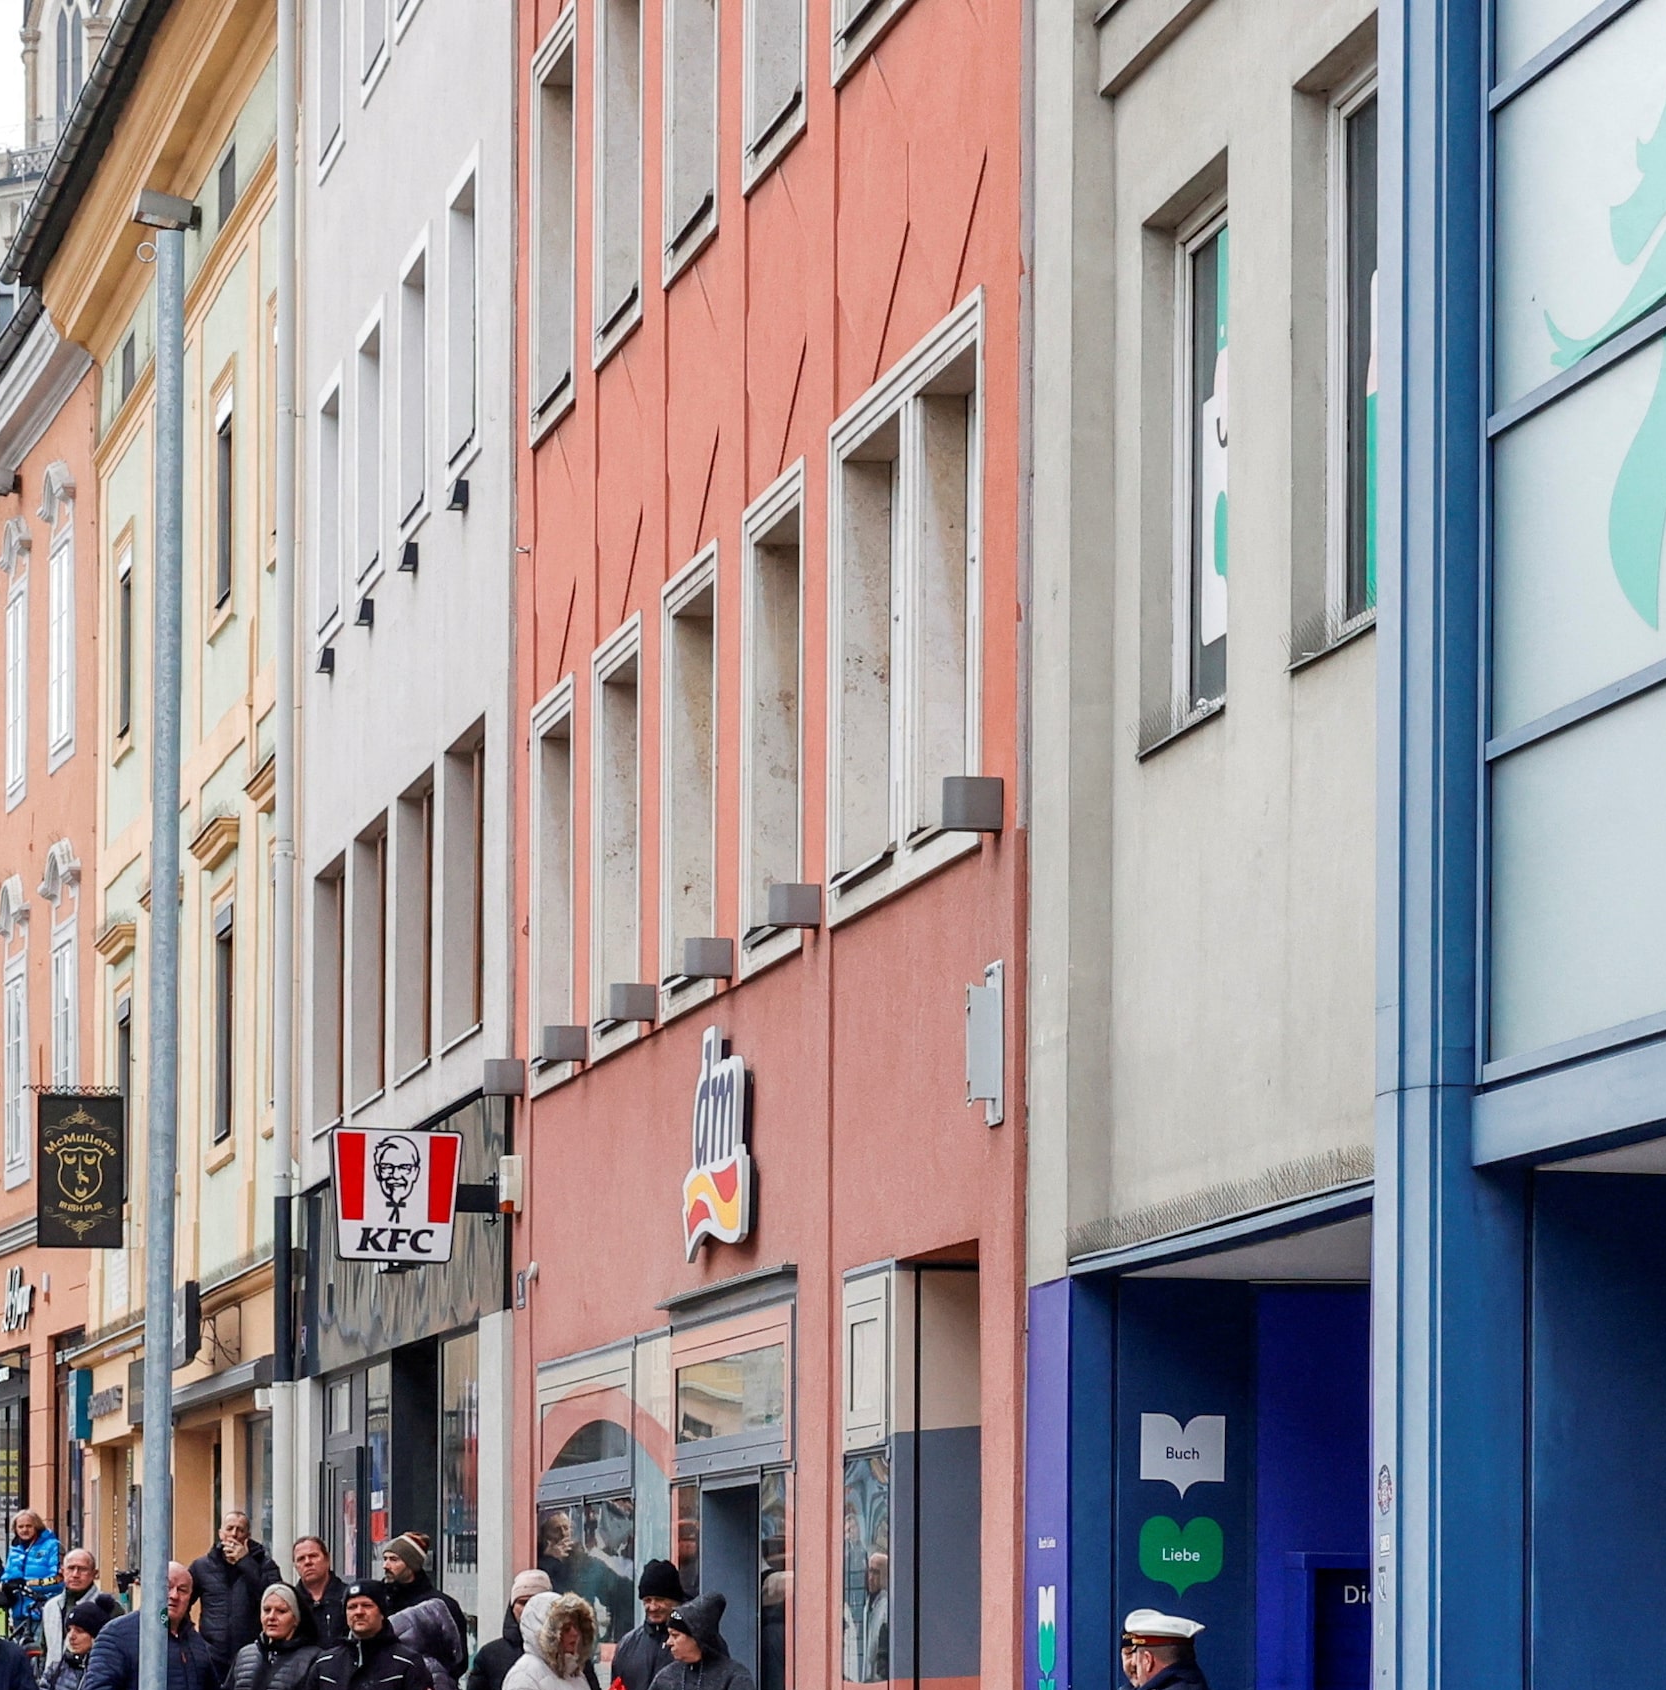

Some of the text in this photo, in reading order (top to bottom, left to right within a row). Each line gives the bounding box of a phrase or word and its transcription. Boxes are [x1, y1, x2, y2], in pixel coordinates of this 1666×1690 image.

[695, 1038, 733, 1170] dm
[43, 1132, 117, 1157] McMullens
[58, 1200, 103, 1212] IRISH PUB
[356, 1226, 435, 1255] KFC
[1166, 1446, 1200, 1460] Buch
[1162, 1547, 1201, 1562] Liebe
[1344, 1585, 1371, 1604] Di
